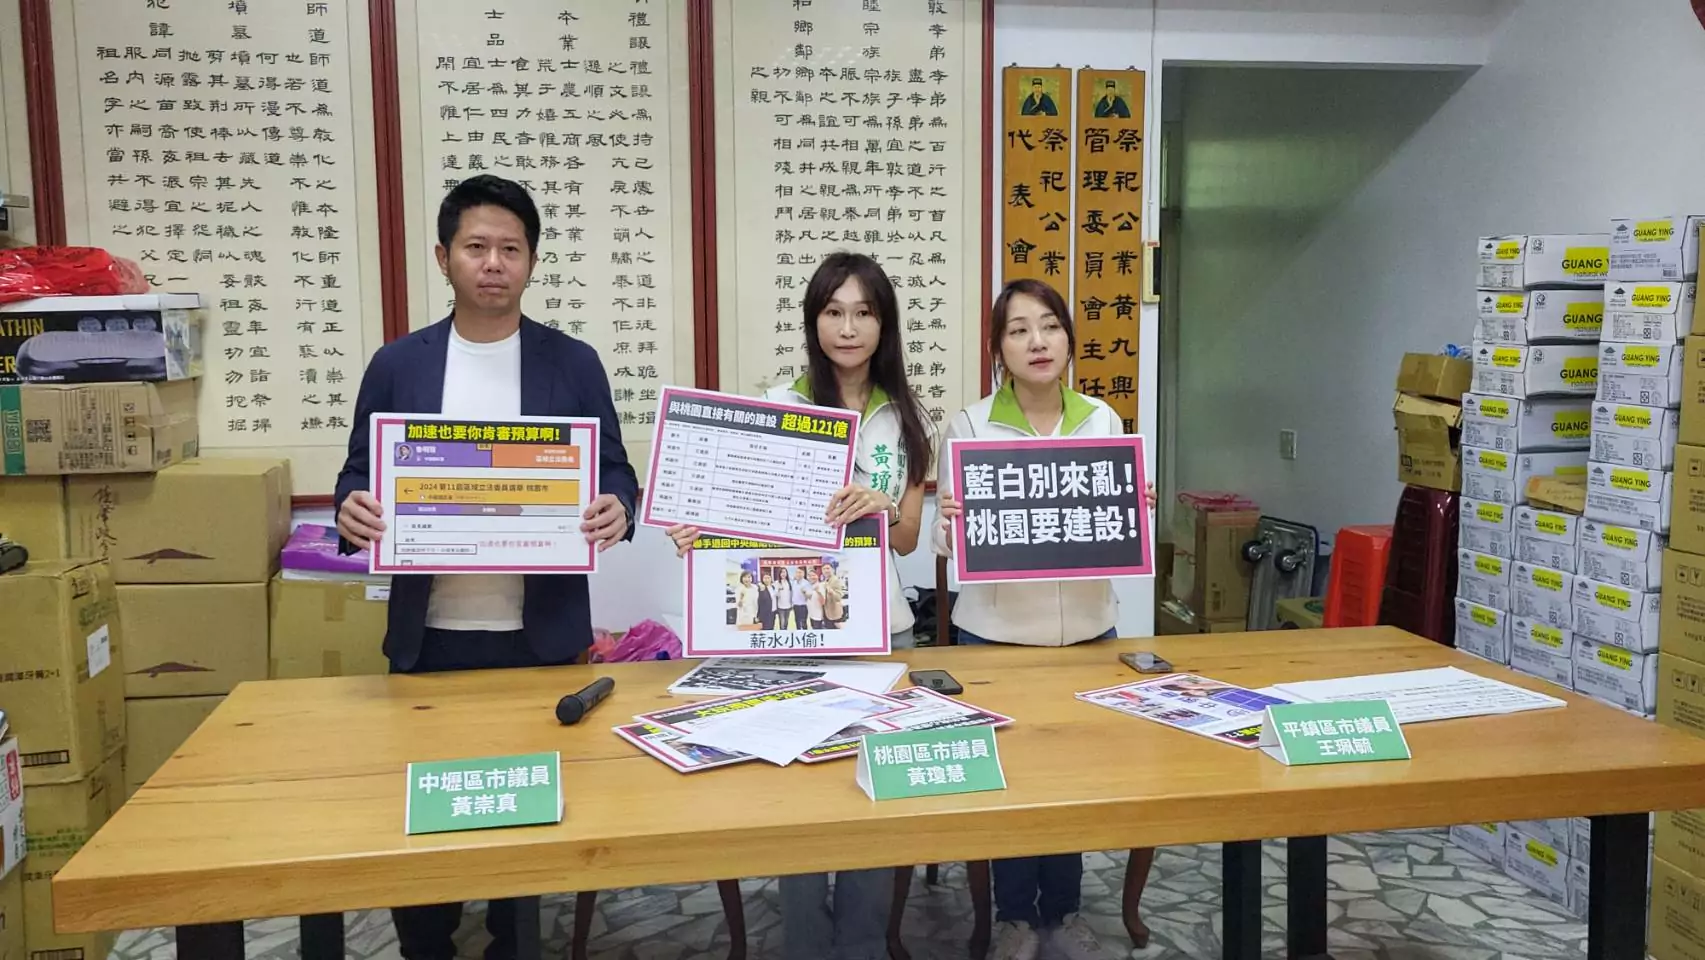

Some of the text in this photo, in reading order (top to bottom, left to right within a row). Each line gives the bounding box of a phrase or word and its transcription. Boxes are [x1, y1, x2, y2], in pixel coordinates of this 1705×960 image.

[1008, 130, 1037, 265] 代表會
[1039, 127, 1068, 276] 祭祀公業
[1658, 228, 1674, 236] YING
[1562, 258, 1602, 270] GUANG
[1632, 294, 1654, 302] GUANG
[1563, 314, 1602, 324] GUANG
[1646, 354, 1660, 362] YING
[1560, 368, 1598, 379] GUANG
[1480, 405, 1496, 414] GUANG
[668, 400, 777, 429] 與桃園直接有關的建設
[781, 412, 848, 439] 超過121億
[1614, 414, 1636, 422] GUANG
[408, 424, 560, 442] 加速也要你肯審預算啊!
[1552, 422, 1588, 432] GUANG
[419, 483, 438, 491] 2024
[963, 460, 1135, 501] 藍白別來亂!
[1610, 475, 1652, 488] GUANG YING
[965, 505, 1138, 547] 桃園要建設!
[1602, 532, 1622, 544] GUANG
[750, 633, 825, 649] 薪水小偷!
[1282, 716, 1393, 738] 平鎮區市議員
[873, 739, 990, 766] 桃園區市議員
[1317, 737, 1375, 757] 王珮毓
[418, 765, 550, 794] 中壢區市議員
[907, 764, 967, 787] 黃瓊慧
[451, 793, 518, 817] 黃崇真
